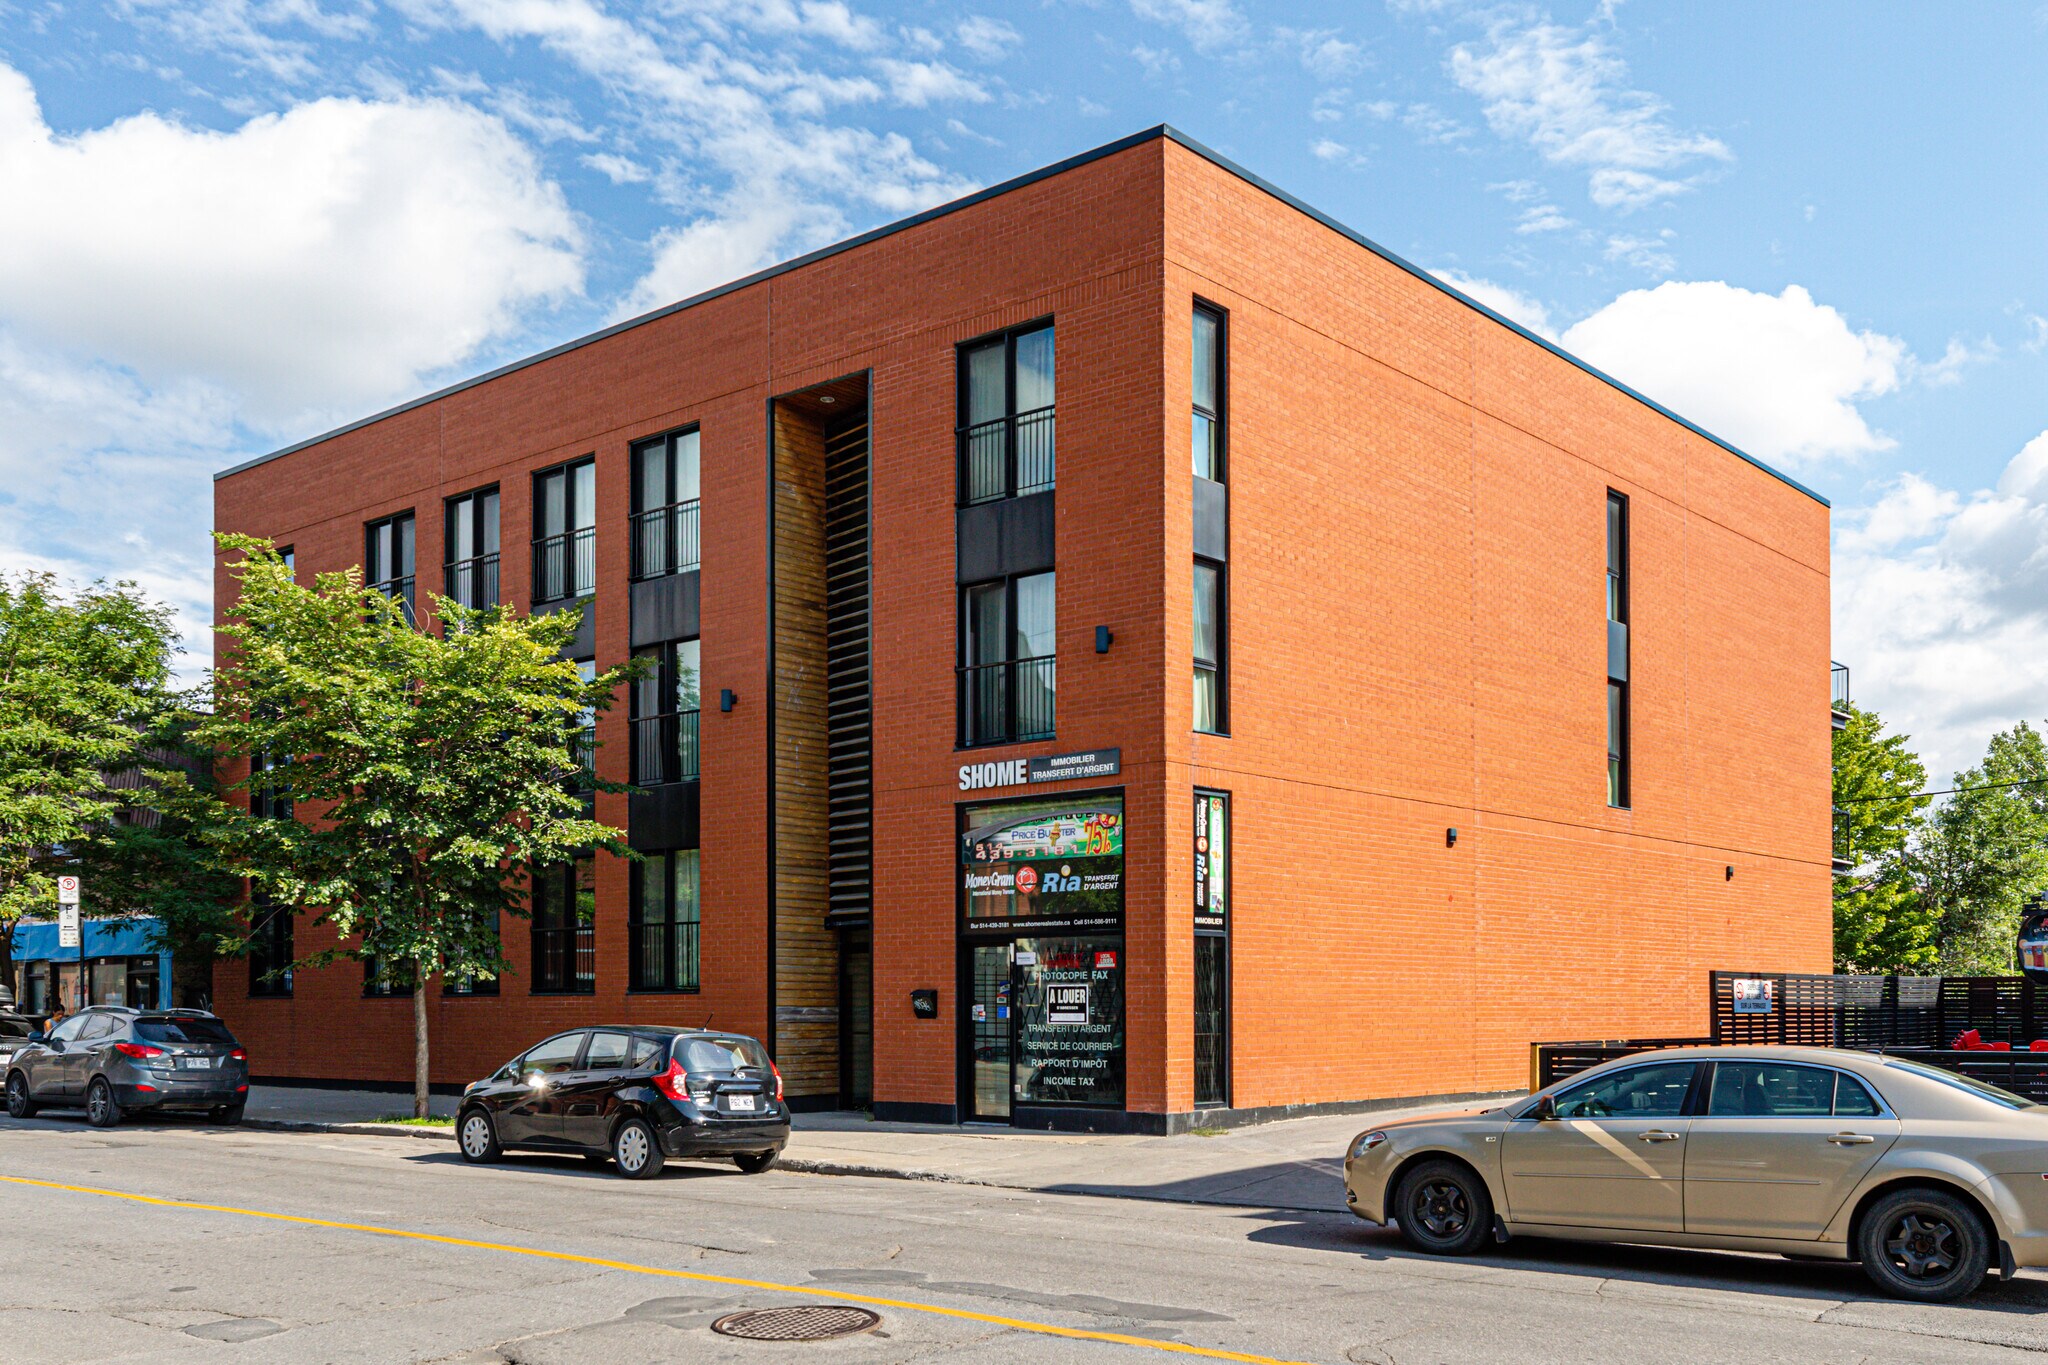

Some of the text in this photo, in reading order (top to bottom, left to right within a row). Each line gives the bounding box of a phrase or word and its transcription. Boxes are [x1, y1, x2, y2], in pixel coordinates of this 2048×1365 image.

[1051, 754, 1095, 767] IMMOBILIER
[959, 759, 1027, 791] SHOME
[1032, 763, 1114, 780] TRANSFERT D'ARGENT
[1012, 827, 1076, 840] PRICE BUTER
[965, 872, 1015, 890] MoneyGram
[1041, 864, 1081, 893] Ria
[1084, 874, 1119, 882] TRANSFERT
[1084, 881, 1119, 891] D'ARGENT
[1195, 916, 1223, 925] IMMOBILIER
[1034, 970, 1108, 980] PHOTOCOPIE FAX
[1057, 989, 1086, 1004] LOUER
[1028, 1024, 1111, 1033] TRANSFERT D'ARGENT
[1027, 1041, 1113, 1051] SERVICE DE COURRIER
[1031, 1058, 1108, 1068] RAPPORT D'IMPÔT
[1043, 1077, 1095, 1086] INCOME TAX
